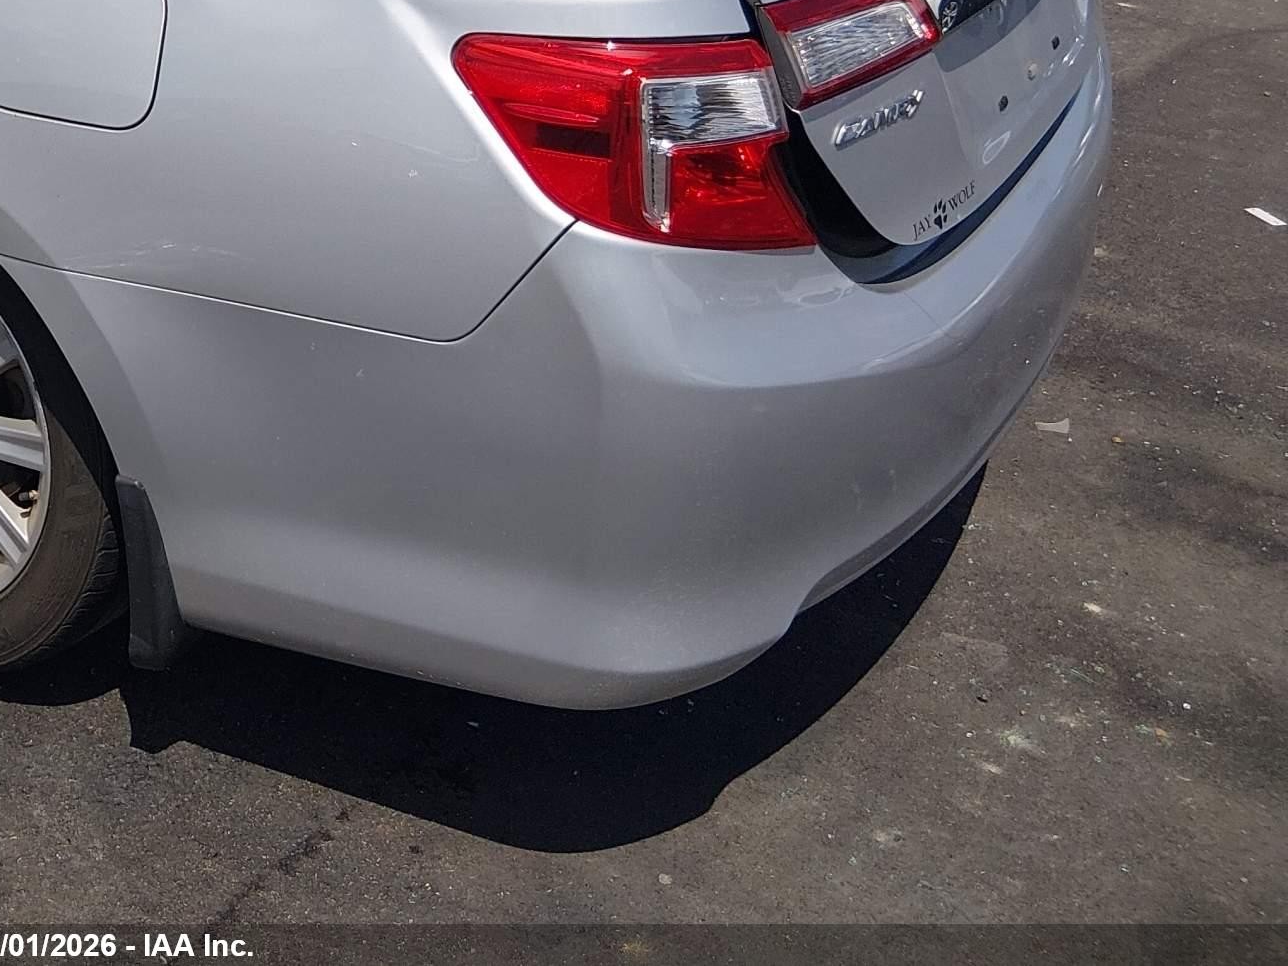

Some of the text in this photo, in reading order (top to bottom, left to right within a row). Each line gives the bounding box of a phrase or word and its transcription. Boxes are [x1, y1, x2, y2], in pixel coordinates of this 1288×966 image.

[832, 89, 925, 147] CAMRY
[912, 179, 976, 241] JAY WOLF
